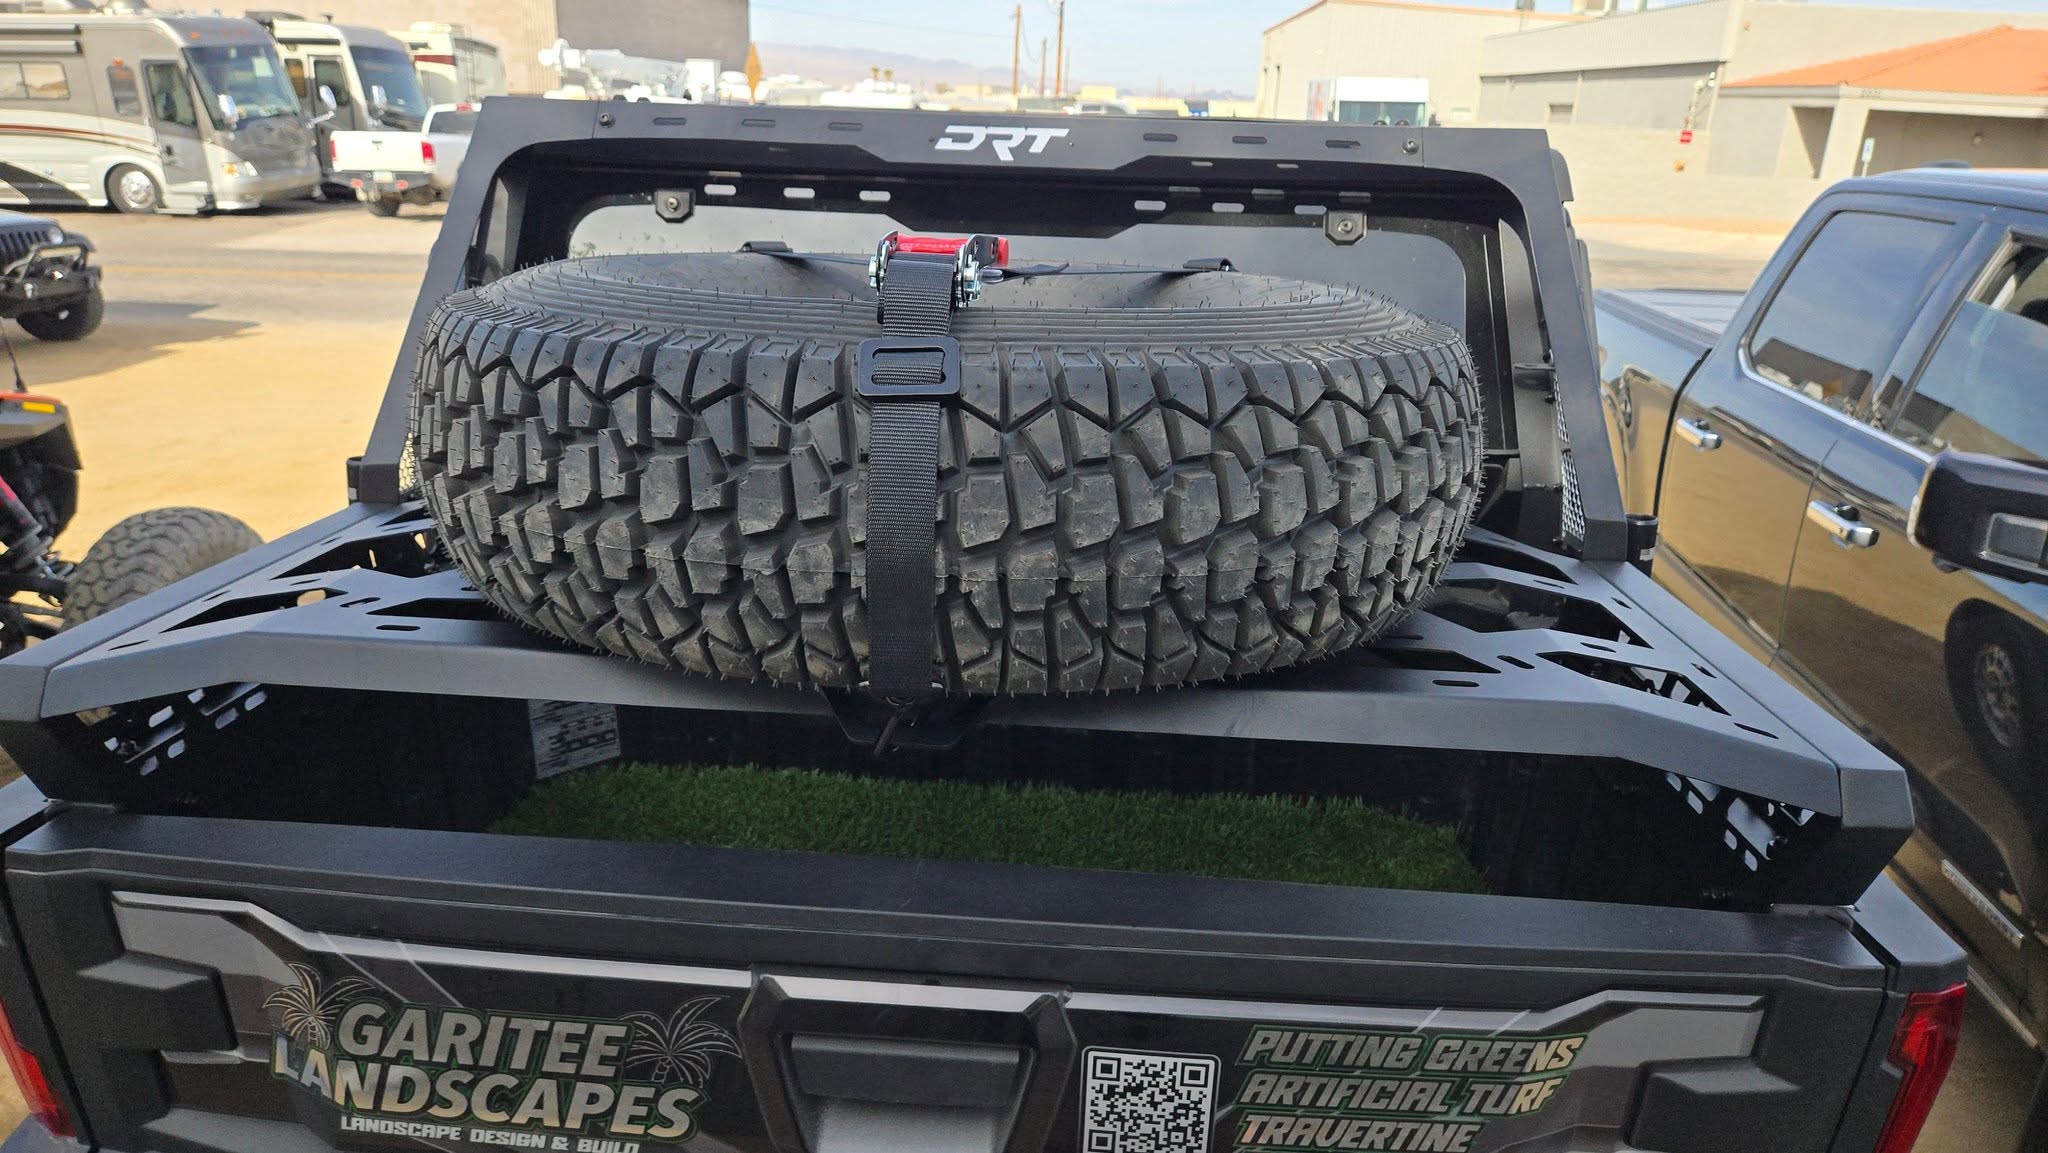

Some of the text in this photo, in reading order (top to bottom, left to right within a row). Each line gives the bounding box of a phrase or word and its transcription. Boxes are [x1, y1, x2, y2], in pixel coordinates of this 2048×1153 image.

[935, 125, 1069, 161] DRT
[338, 1002, 628, 1077] GARITEE
[1243, 1030, 1584, 1073] PUTTING GREENS
[275, 1035, 700, 1138] LANDSCAPES
[1240, 1073, 1563, 1114] ARTIFICIAL TURF
[340, 1115, 640, 1153] LANDSCAPE DESIGN & BUILD
[1241, 1115, 1481, 1153] TRAVERTINE
